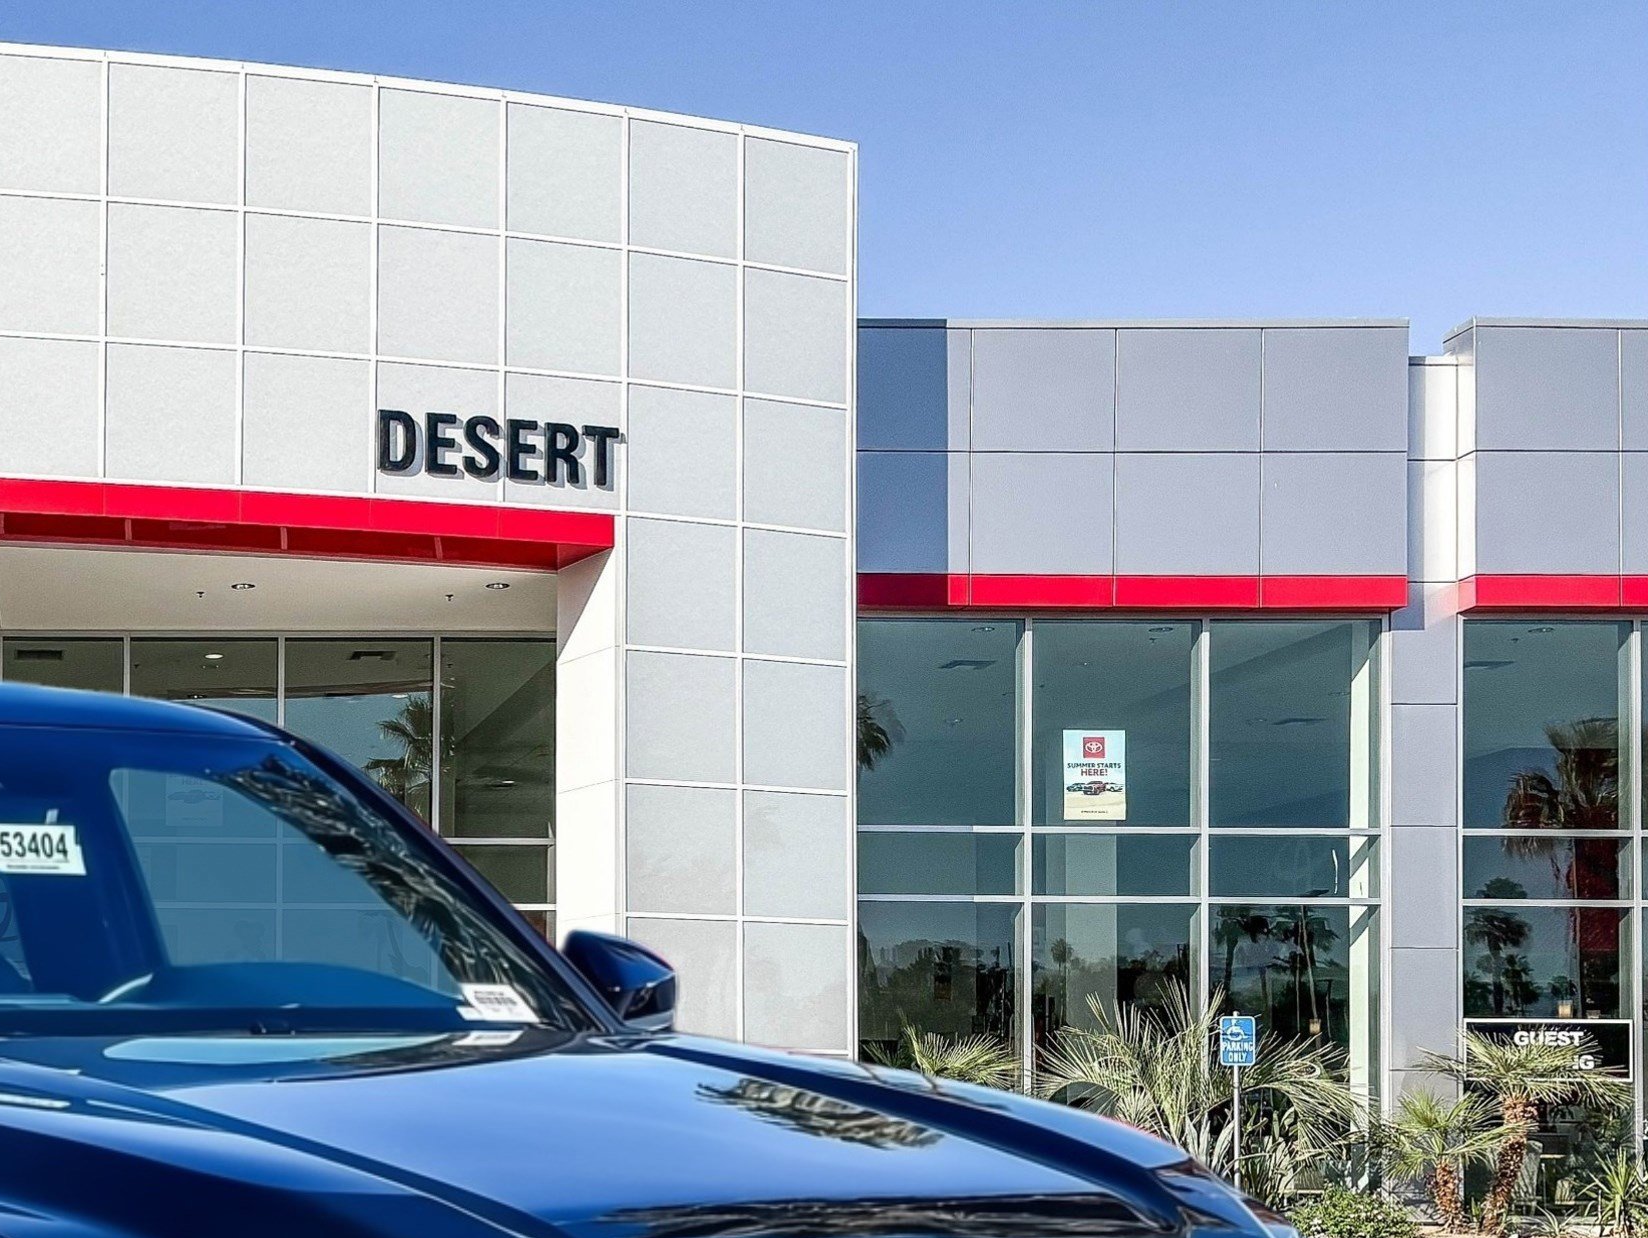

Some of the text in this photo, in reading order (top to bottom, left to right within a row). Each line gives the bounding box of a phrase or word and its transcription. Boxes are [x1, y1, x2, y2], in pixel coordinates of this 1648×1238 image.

[377, 409, 620, 486] DESERT
[1514, 1031, 1584, 1046] GUEST
[1223, 1042, 1253, 1051] PARKING
[1228, 1052, 1247, 1062] ONLY
